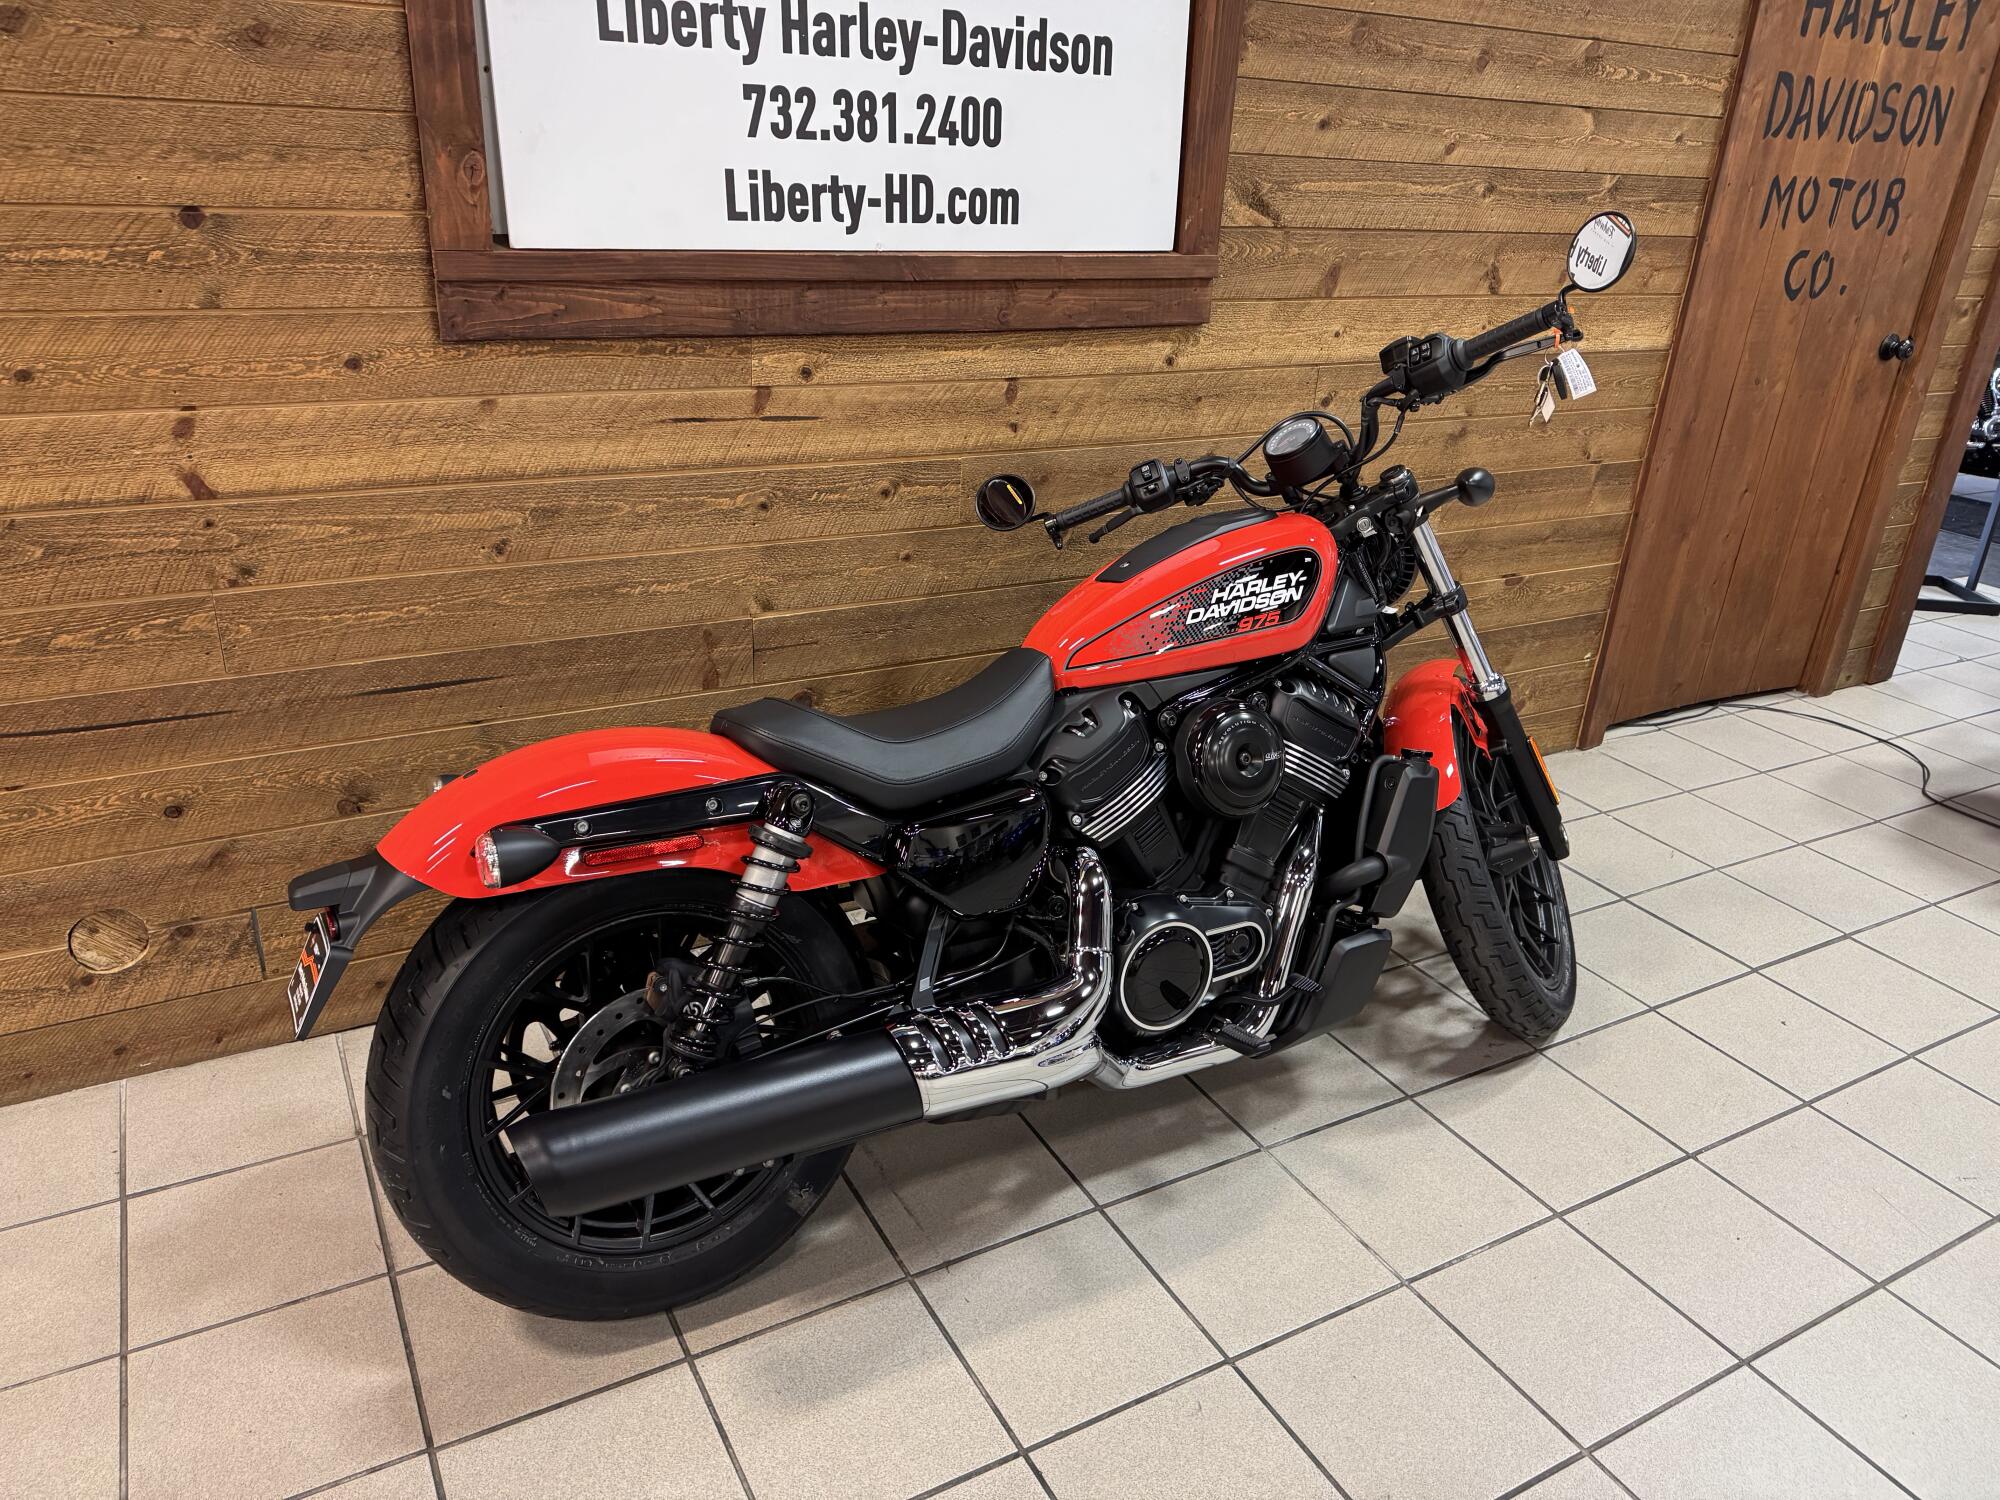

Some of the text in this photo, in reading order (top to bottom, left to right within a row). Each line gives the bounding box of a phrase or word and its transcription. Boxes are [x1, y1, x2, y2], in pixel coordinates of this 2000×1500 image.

[596, 0, 1113, 77] Liberty Harley-Davidson
[1800, 0, 1982, 51] HARLEY
[742, 84, 1003, 148] 732.381.2400
[1762, 70, 1955, 148] DAVIDSON
[724, 168, 1020, 236] Liberty-HD.com
[1759, 174, 1906, 237] MOTOR
[1783, 249, 1848, 302] CO.
[1185, 585, 1305, 625] DAVIDSON
[1211, 570, 1308, 604] HARLEY-
[1237, 610, 1281, 632] 975
